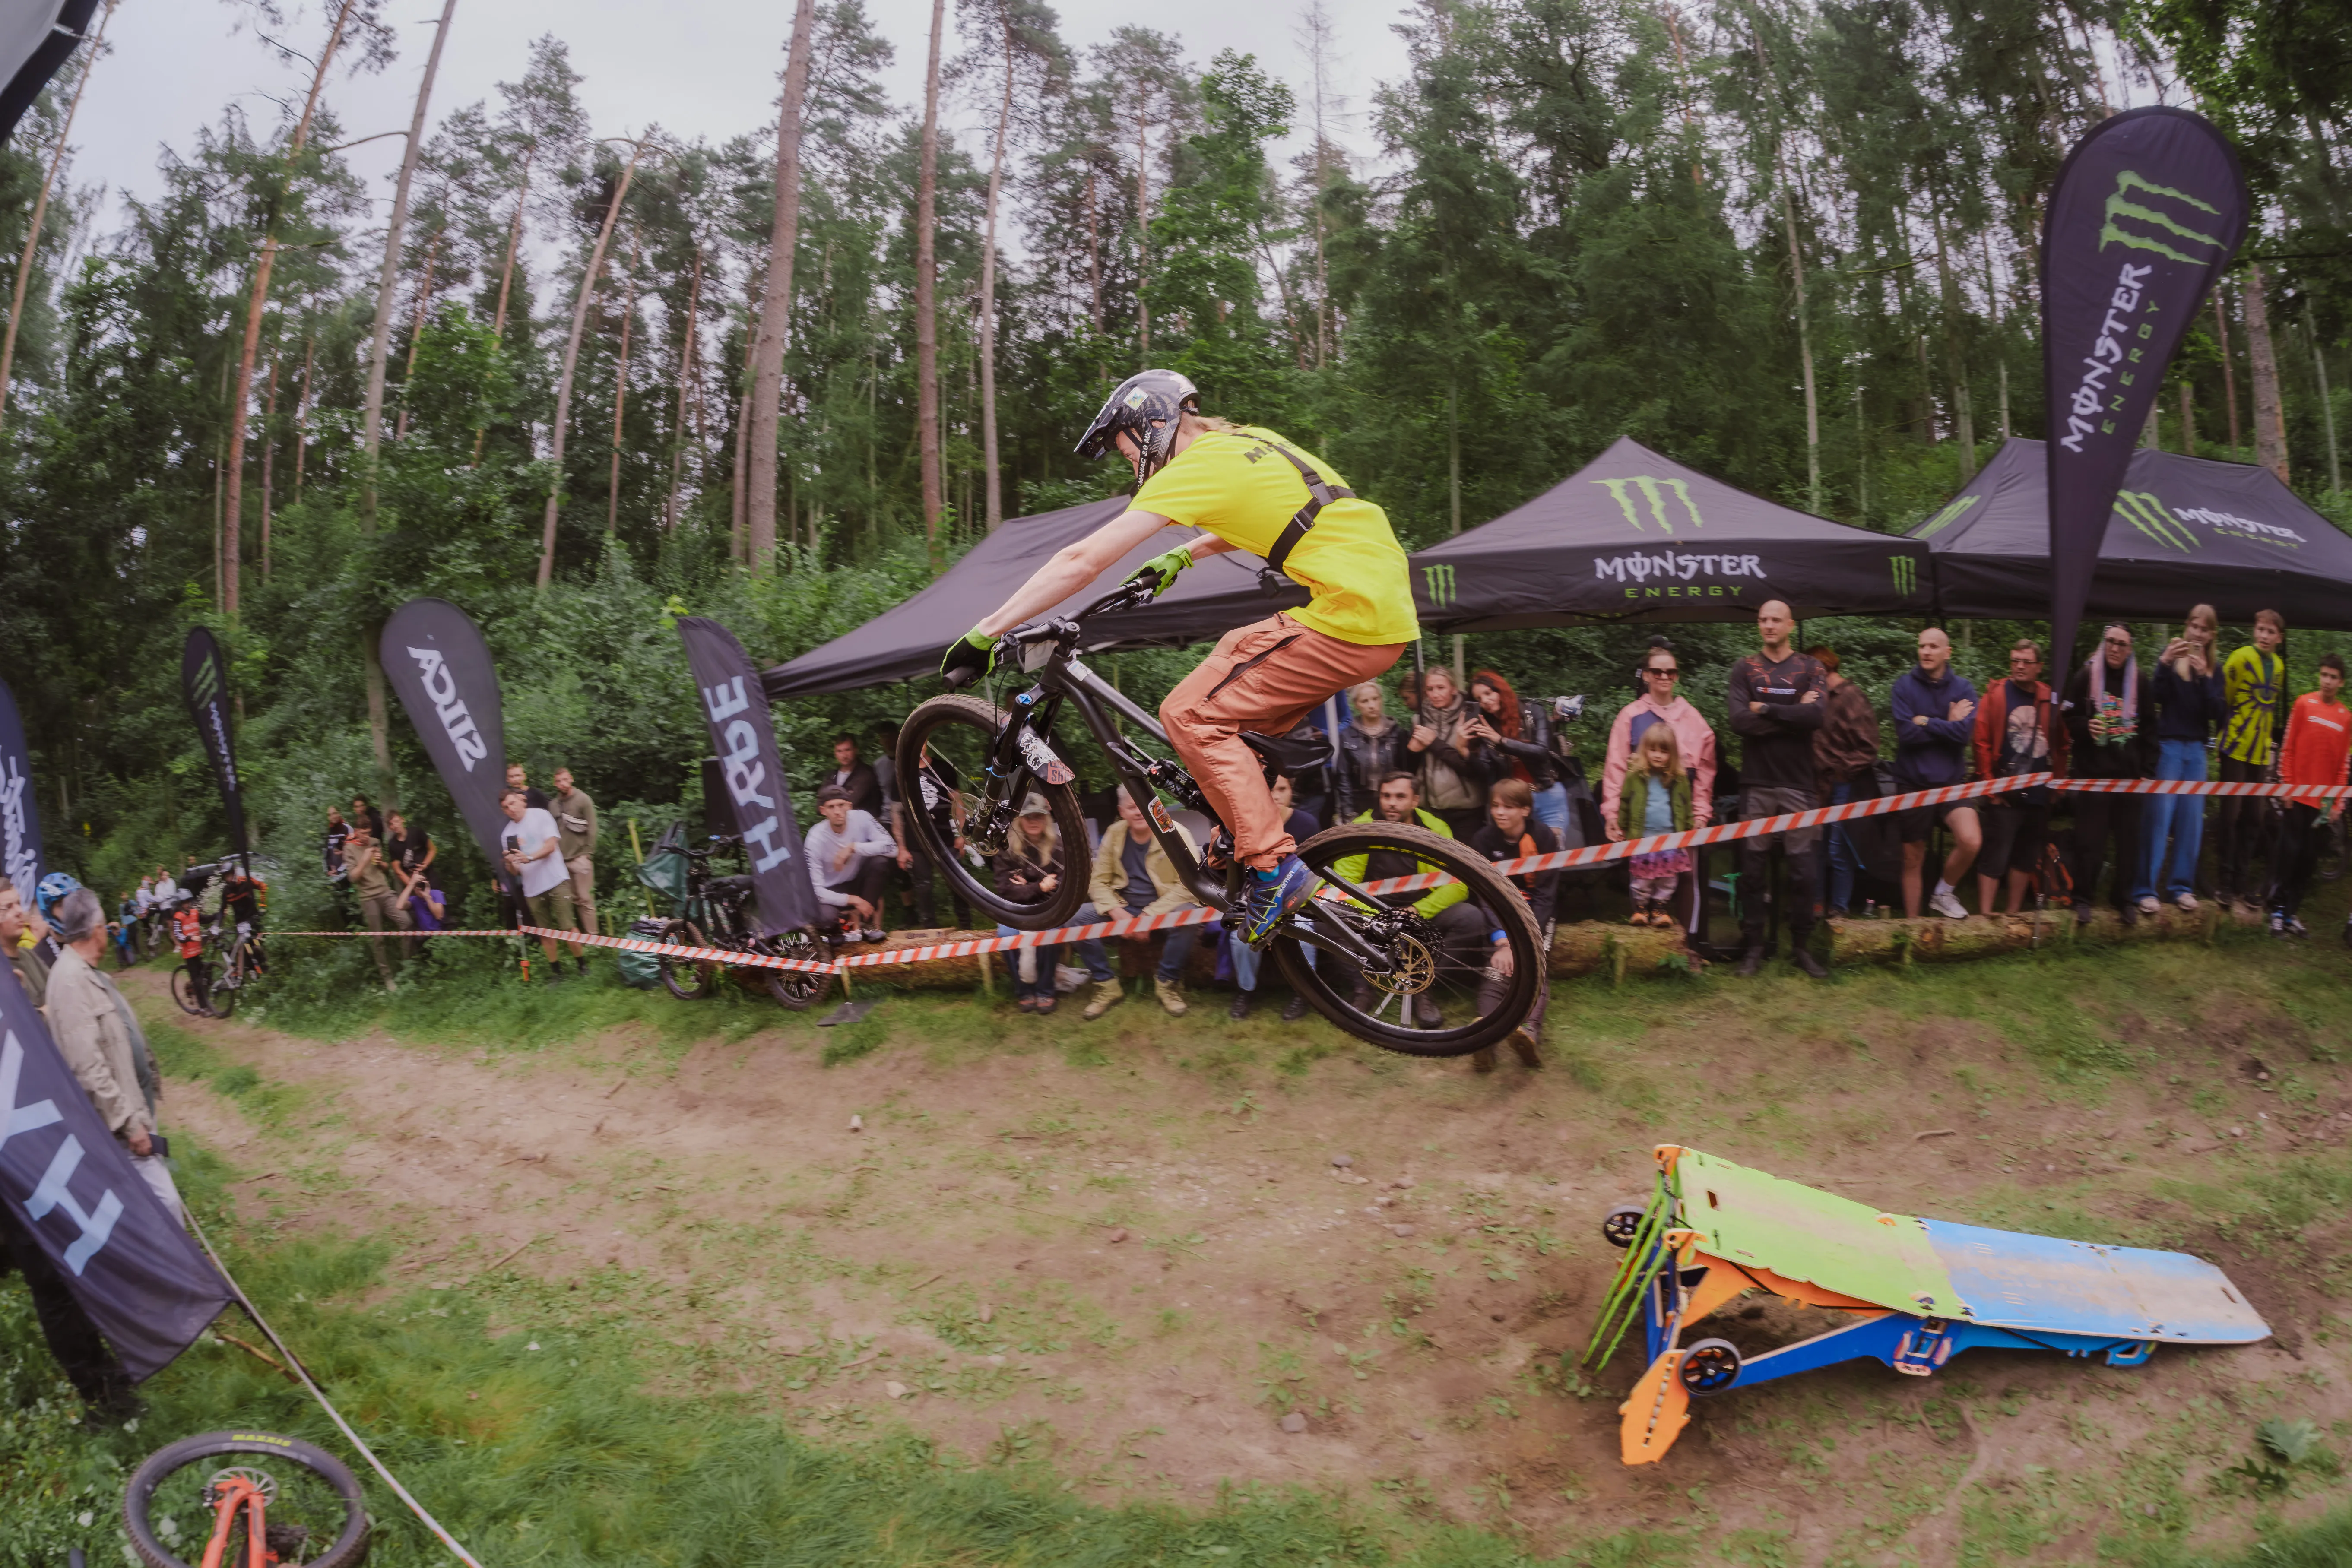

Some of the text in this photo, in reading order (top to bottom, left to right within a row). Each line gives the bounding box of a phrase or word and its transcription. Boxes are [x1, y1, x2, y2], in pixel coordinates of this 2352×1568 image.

[2060, 263, 2152, 453] MONSTER
[2101, 300, 2160, 435] ENERGY
[1144, 431, 1151, 444] MX
[2172, 507, 2308, 543] MONSTER
[1594, 550, 1767, 582] MONSTER
[1624, 586, 1743, 598] ENERGY
